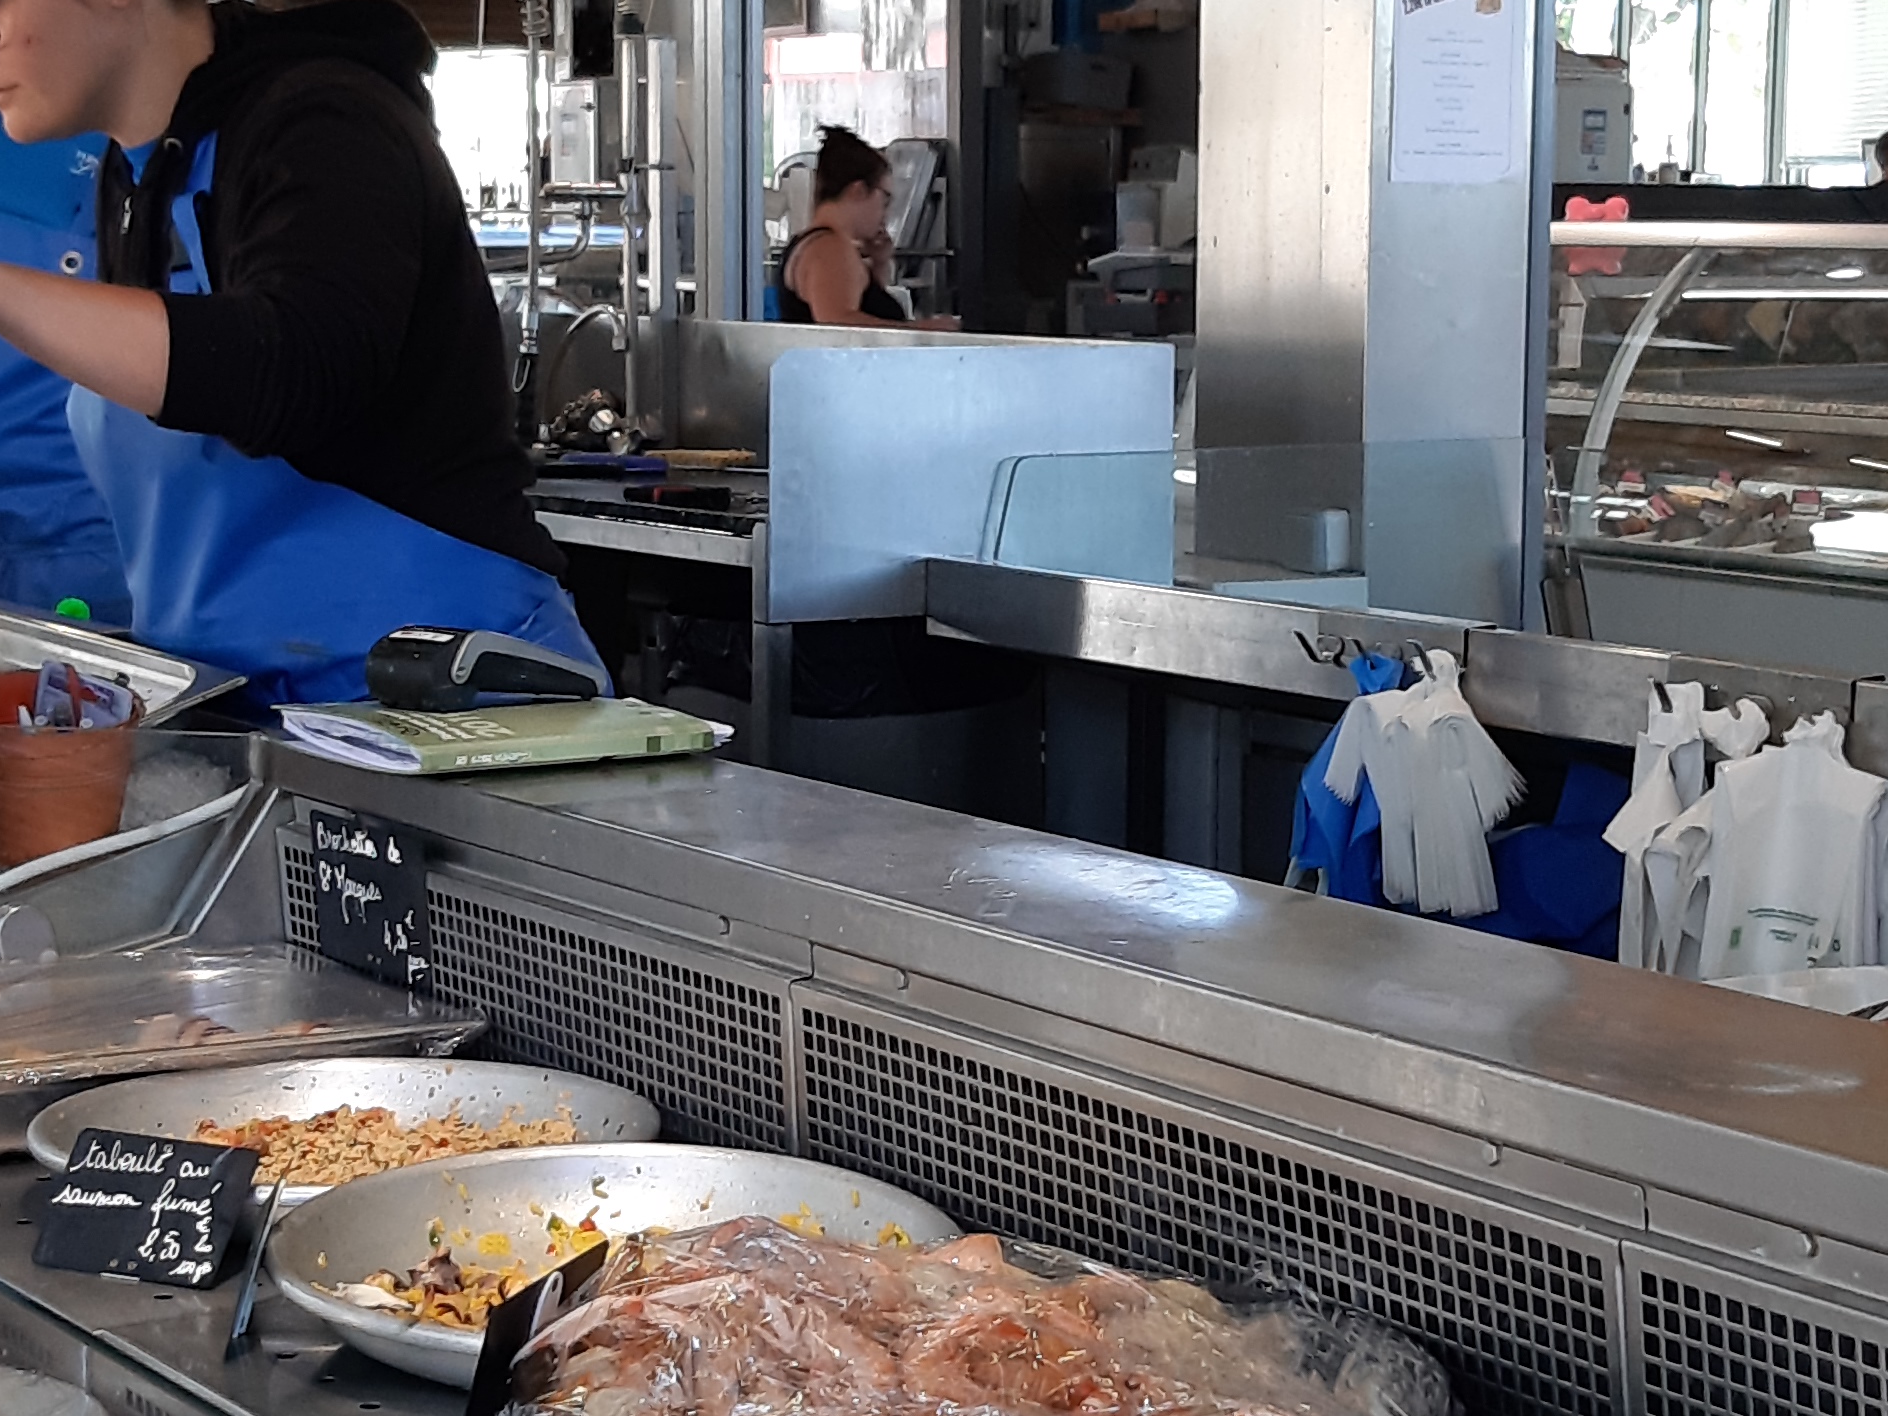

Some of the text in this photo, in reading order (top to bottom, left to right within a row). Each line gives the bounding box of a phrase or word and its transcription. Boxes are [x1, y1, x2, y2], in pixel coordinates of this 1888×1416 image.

[179, 1160, 212, 1178] au
[52, 1178, 223, 1227] saumon fumé
